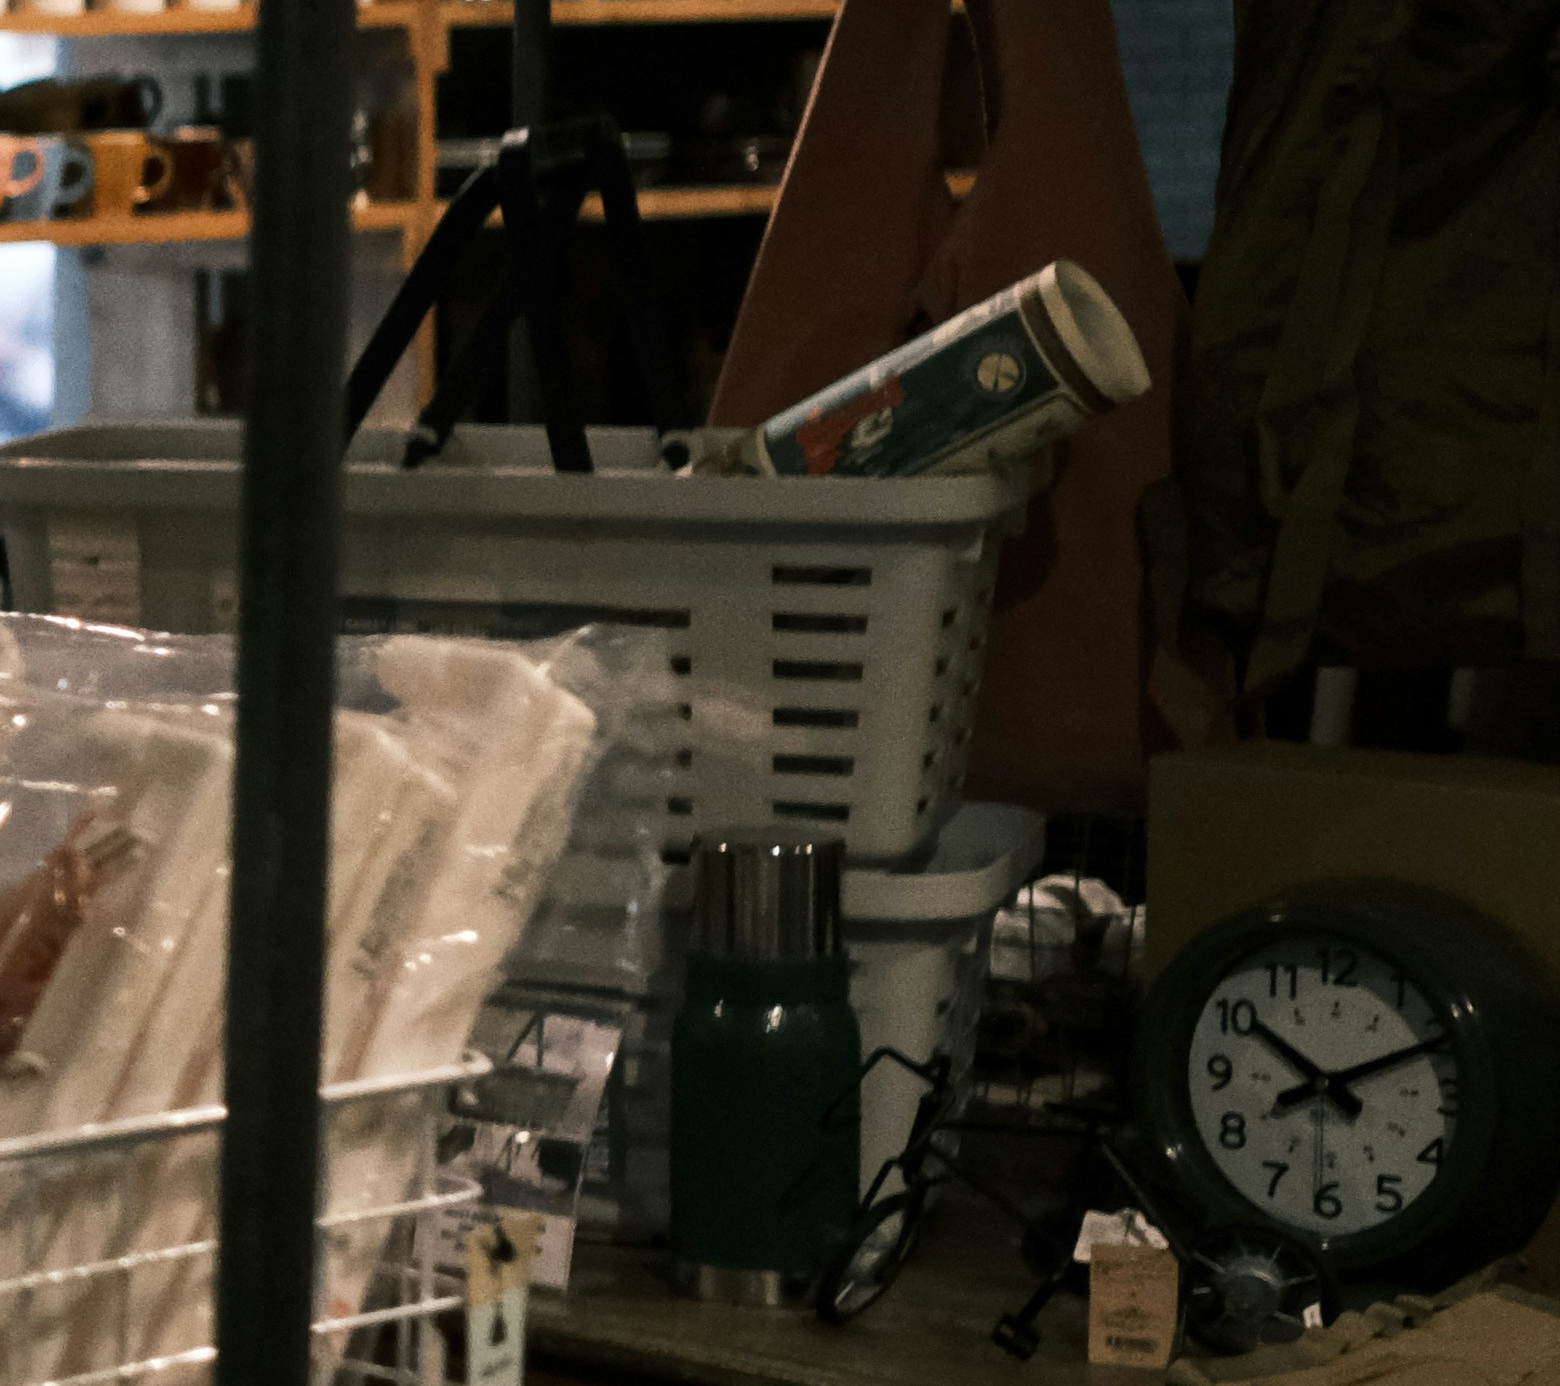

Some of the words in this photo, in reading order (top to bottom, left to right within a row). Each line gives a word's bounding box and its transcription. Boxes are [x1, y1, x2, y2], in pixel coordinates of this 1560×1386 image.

[1264, 963, 1299, 1001] 11
[1317, 948, 1357, 988] 12
[1391, 970, 1409, 1008] 1
[1216, 998, 1257, 1036] 10
[1207, 1053, 1233, 1092] 9
[1220, 1111, 1247, 1150] 8
[1416, 1138, 1446, 1167] 4
[1262, 1160, 1289, 1198] 7
[1376, 1174, 1404, 1213] 5
[1313, 1181, 1343, 1220] 6
